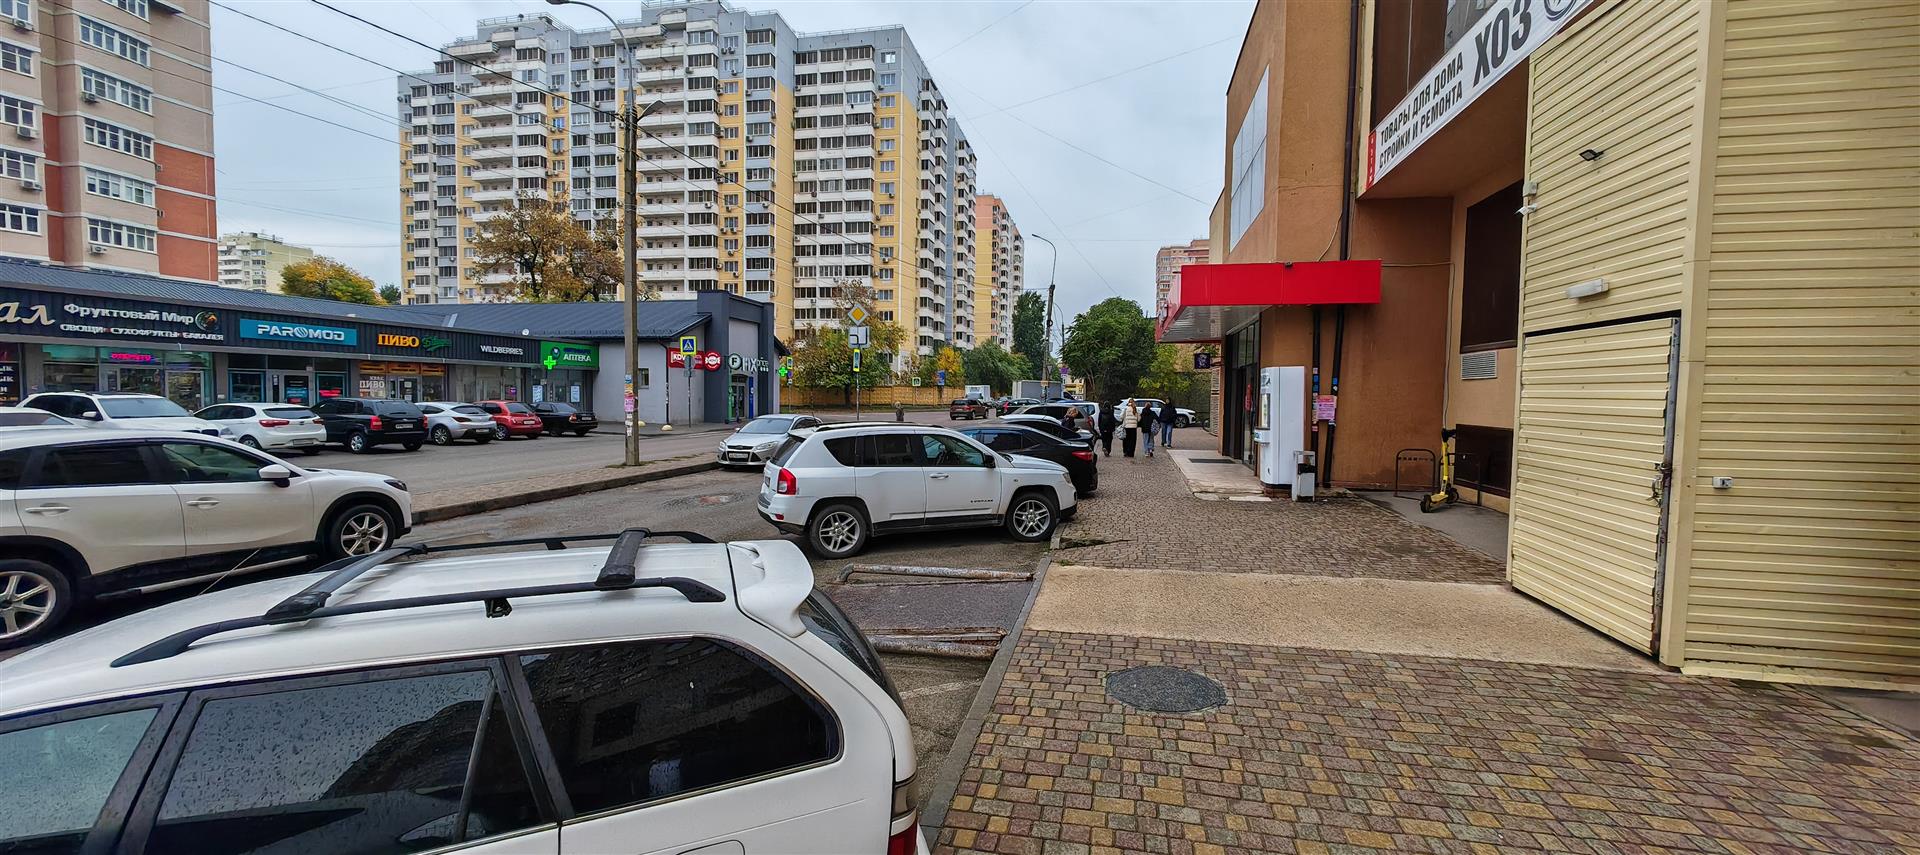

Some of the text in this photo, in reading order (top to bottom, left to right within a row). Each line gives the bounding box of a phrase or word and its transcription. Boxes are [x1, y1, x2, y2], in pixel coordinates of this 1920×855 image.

[1473, 0, 1532, 88] ХОЗ
[1380, 52, 1464, 147] ТОВАРЫ ДЛЯ ДОМА
[1379, 127, 1411, 169] СТРОЙКИ
[1412, 121, 1419, 141] И
[1420, 80, 1463, 134] РЕМОНТА
[63, 303, 194, 326] Фруктовый Мир
[59, 323, 104, 334] ОВОЩИ
[256, 324, 345, 341] PAROMOD
[377, 333, 420, 348] ПИВО
[480, 344, 524, 356] WILDBERRIES
[563, 353, 592, 362] АПТЕКА
[359, 380, 385, 389] ПИВО
